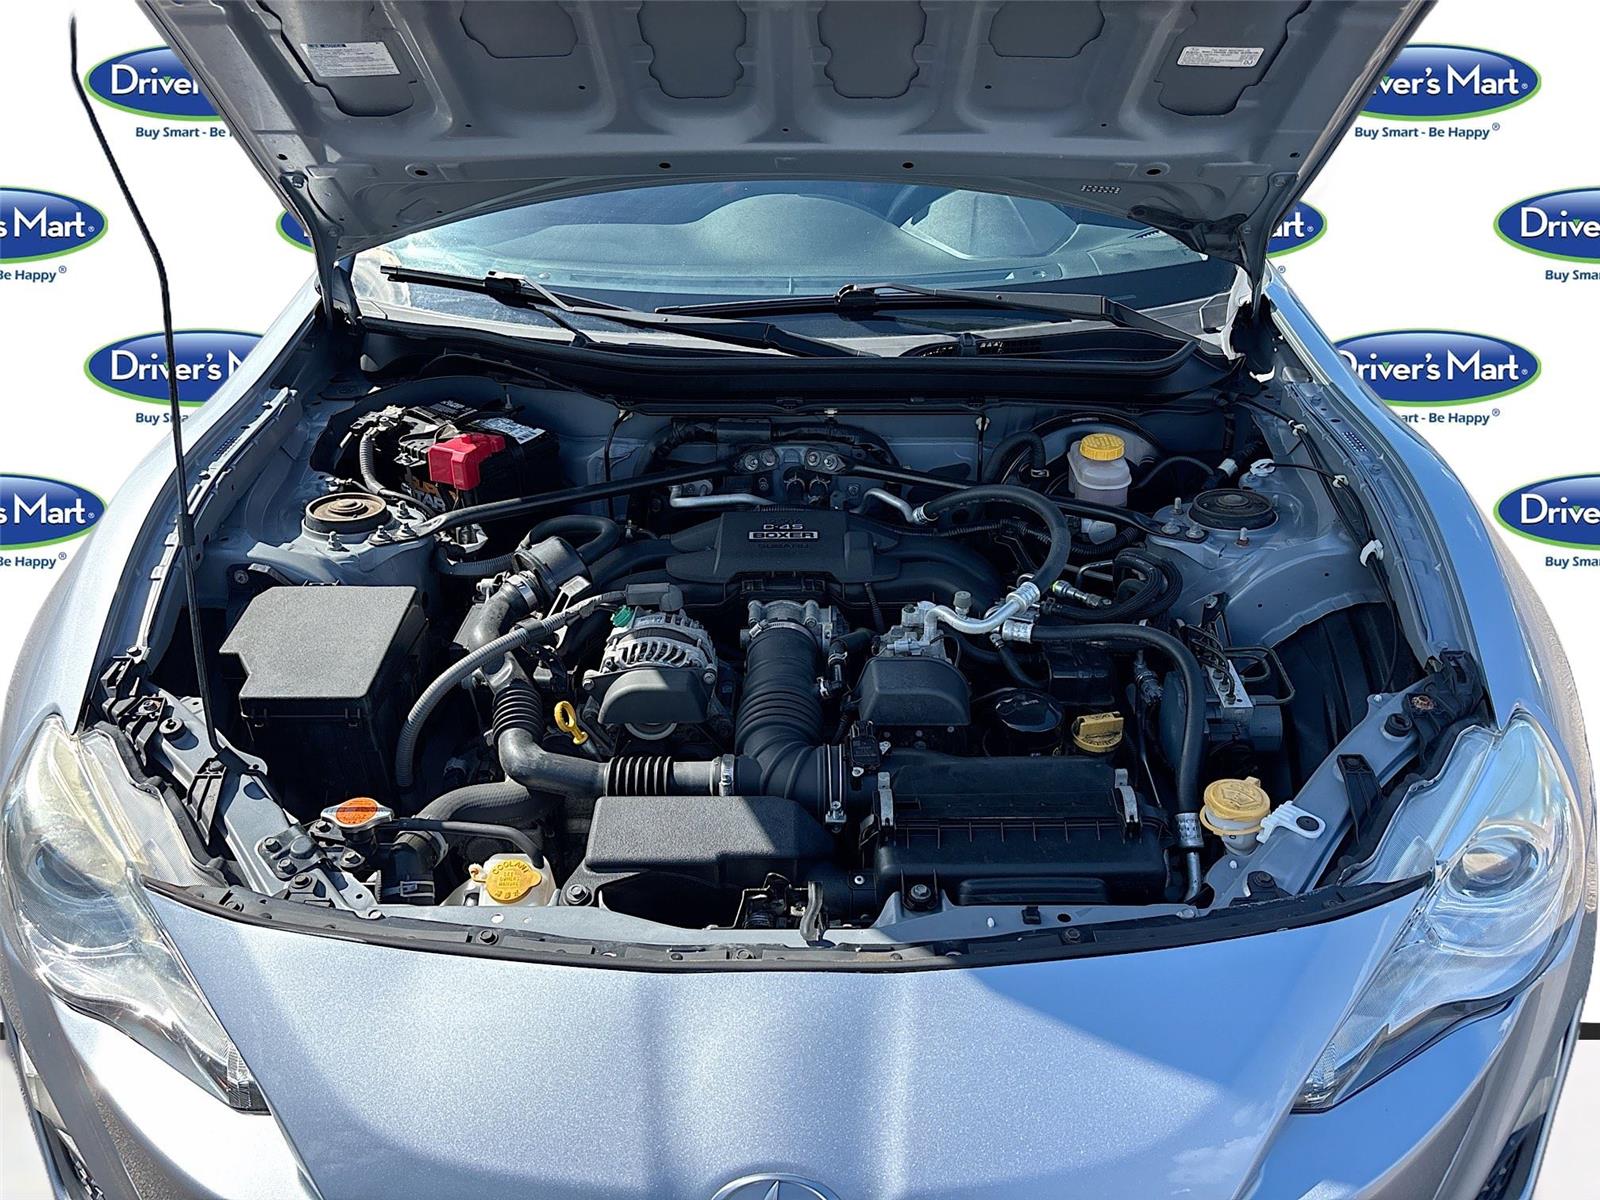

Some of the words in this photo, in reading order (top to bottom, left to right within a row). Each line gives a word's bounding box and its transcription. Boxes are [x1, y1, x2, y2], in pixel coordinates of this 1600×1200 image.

[1373, 67, 1441, 95] ver's
[135, 127, 160, 140] Buy
[163, 127, 200, 138] Smart
[209, 127, 226, 138] Be
[1355, 127, 1379, 140] Buy
[1382, 127, 1419, 138] Smart
[1429, 127, 1445, 138] Be
[1448, 127, 1490, 140] Happy
[1271, 211, 1305, 238] art
[1521, 207, 1600, 238] Drive
[15, 270, 57, 283] Happy
[1545, 269, 1570, 283] Buy
[135, 413, 160, 425] Buy
[1402, 413, 1418, 423] art
[1429, 413, 1445, 423] Be
[1448, 413, 1490, 426] Happy
[1521, 493, 1600, 524] Drive
[752, 531, 815, 540] BOXER
[15, 557, 57, 570] Happy
[1545, 556, 1570, 570] Buy
[492, 861, 529, 875] COOLANT
